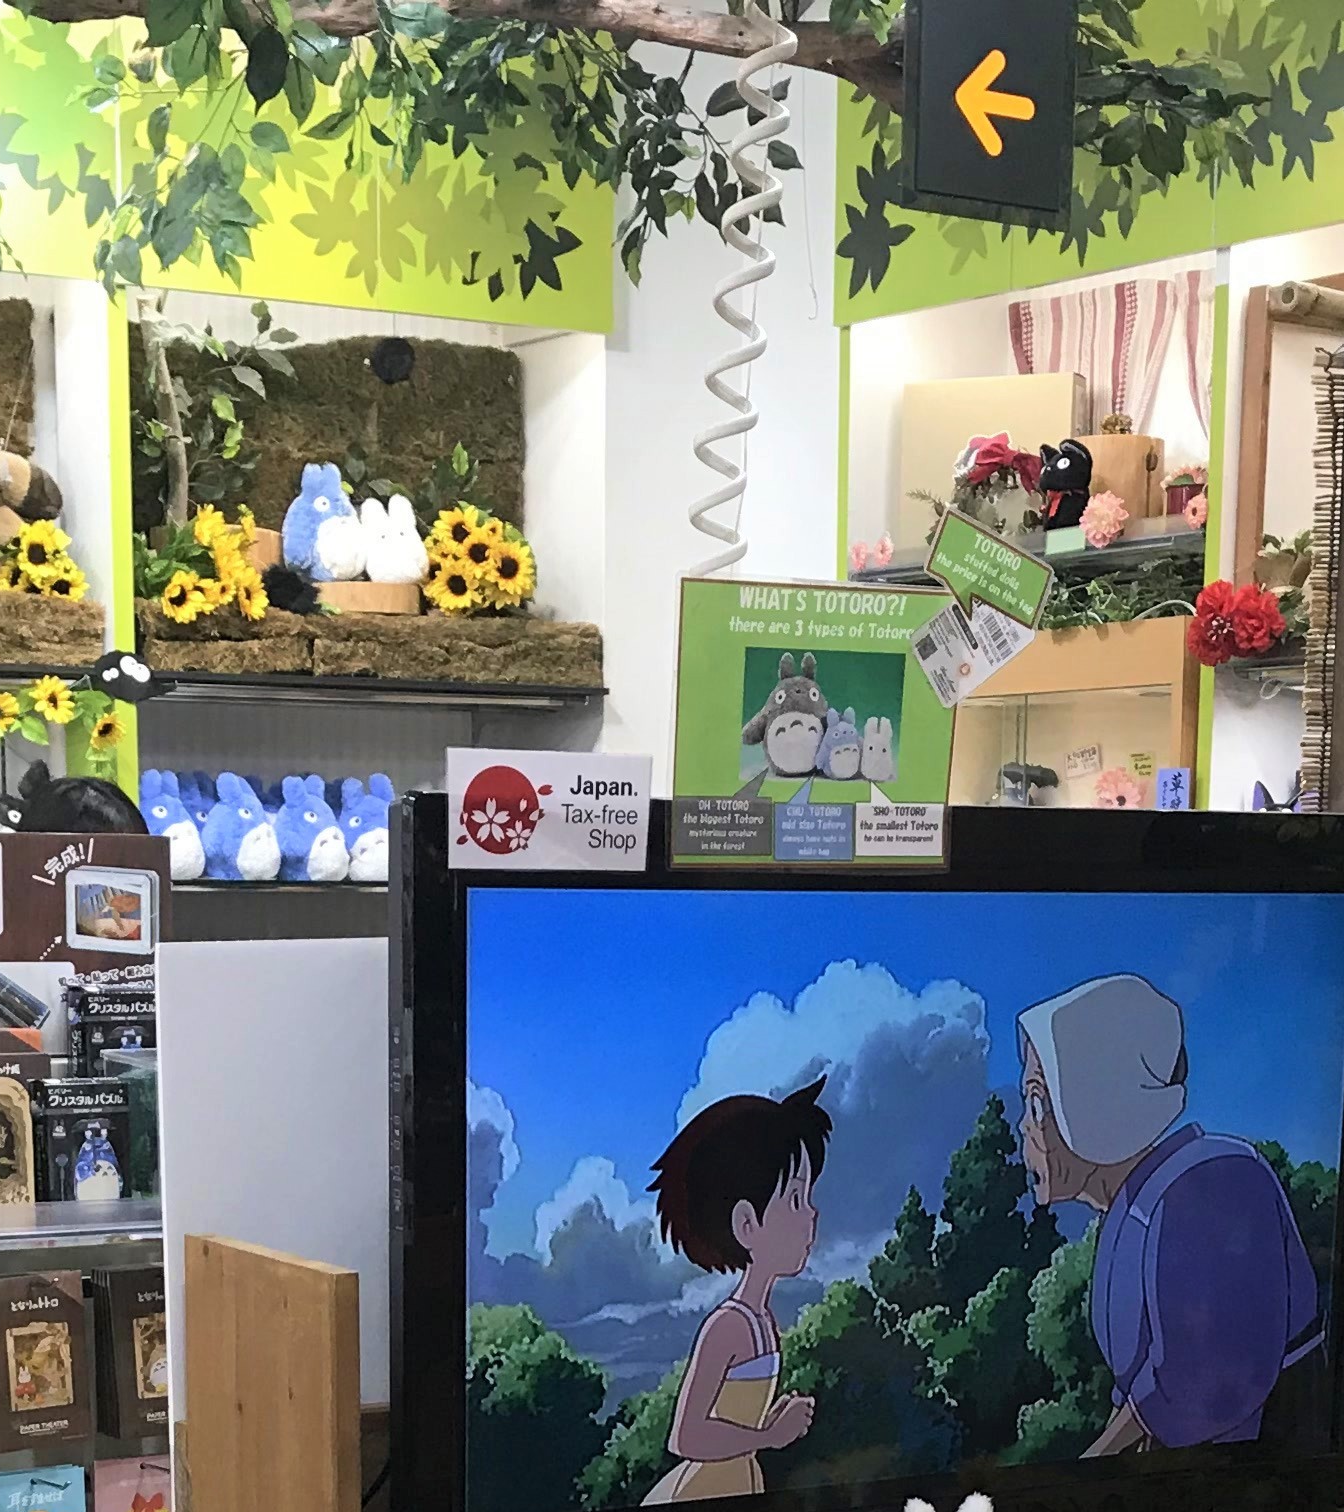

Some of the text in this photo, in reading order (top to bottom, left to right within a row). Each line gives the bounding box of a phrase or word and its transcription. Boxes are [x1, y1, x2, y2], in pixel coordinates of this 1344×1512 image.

[974, 533, 1022, 571] TOTORO
[936, 552, 953, 568] the
[952, 562, 978, 582] price
[978, 575, 988, 587] is
[988, 582, 1001, 597] on
[964, 553, 999, 578] stuffed
[739, 586, 907, 616] WHAT'S TOTORO?!
[729, 616, 765, 633] there
[768, 621, 791, 634] are
[794, 619, 804, 636] 3
[808, 620, 844, 638] types
[848, 622, 864, 638] of
[570, 775, 638, 800] Japan.
[561, 803, 638, 825] Tax-free
[683, 813, 764, 825] the biggest Totoro
[818, 820, 847, 830] Totoro
[860, 818, 939, 831] the smallest Totoro
[588, 829, 637, 854] Shop
[895, 833, 934, 843] transparent
